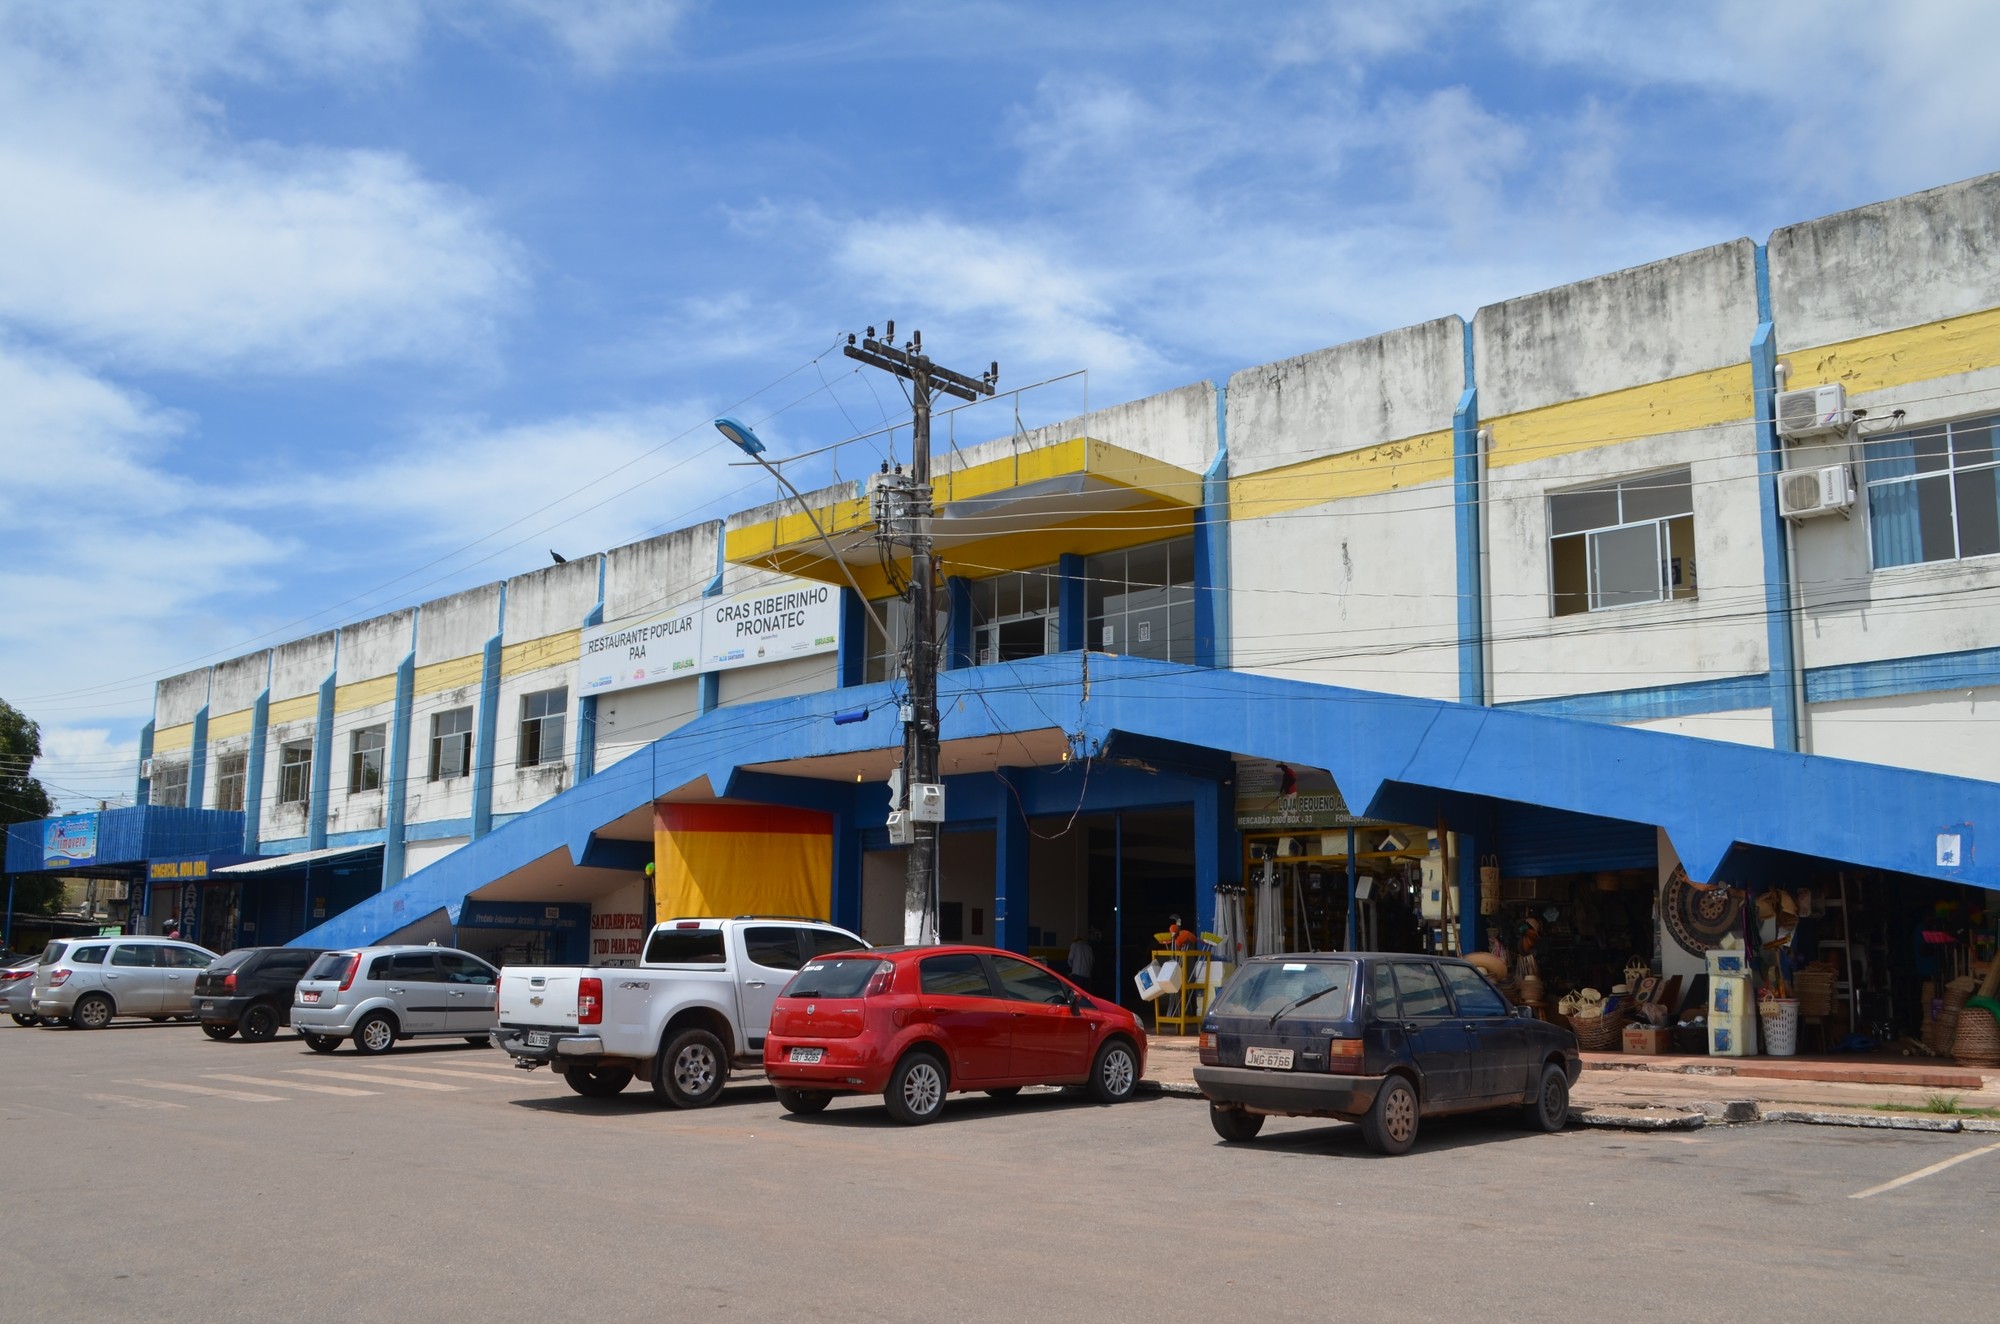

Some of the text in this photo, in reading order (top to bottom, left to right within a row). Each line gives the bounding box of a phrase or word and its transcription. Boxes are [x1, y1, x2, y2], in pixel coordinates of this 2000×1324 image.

[716, 586, 829, 624] CRAS RIBEIRINHO
[736, 610, 806, 638] PRONATEC
[588, 616, 693, 654] RESTAURANTE POPULAR
[814, 635, 836, 646] BRASIL
[629, 644, 647, 661] PAA
[672, 658, 695, 671] BRASIL
[1277, 796, 1298, 812] LOJA
[1299, 795, 1334, 812] PEQUENO
[1237, 813, 1271, 826] MERCADÃO
[1287, 815, 1300, 824] BOX
[1304, 814, 1313, 823] 33
[182, 882, 197, 942] ARMACIA
[591, 912, 625, 930] SANTARÉM
[625, 913, 643, 930] PESCA
[593, 938, 610, 955] TUDO
[610, 938, 626, 955] PARA
